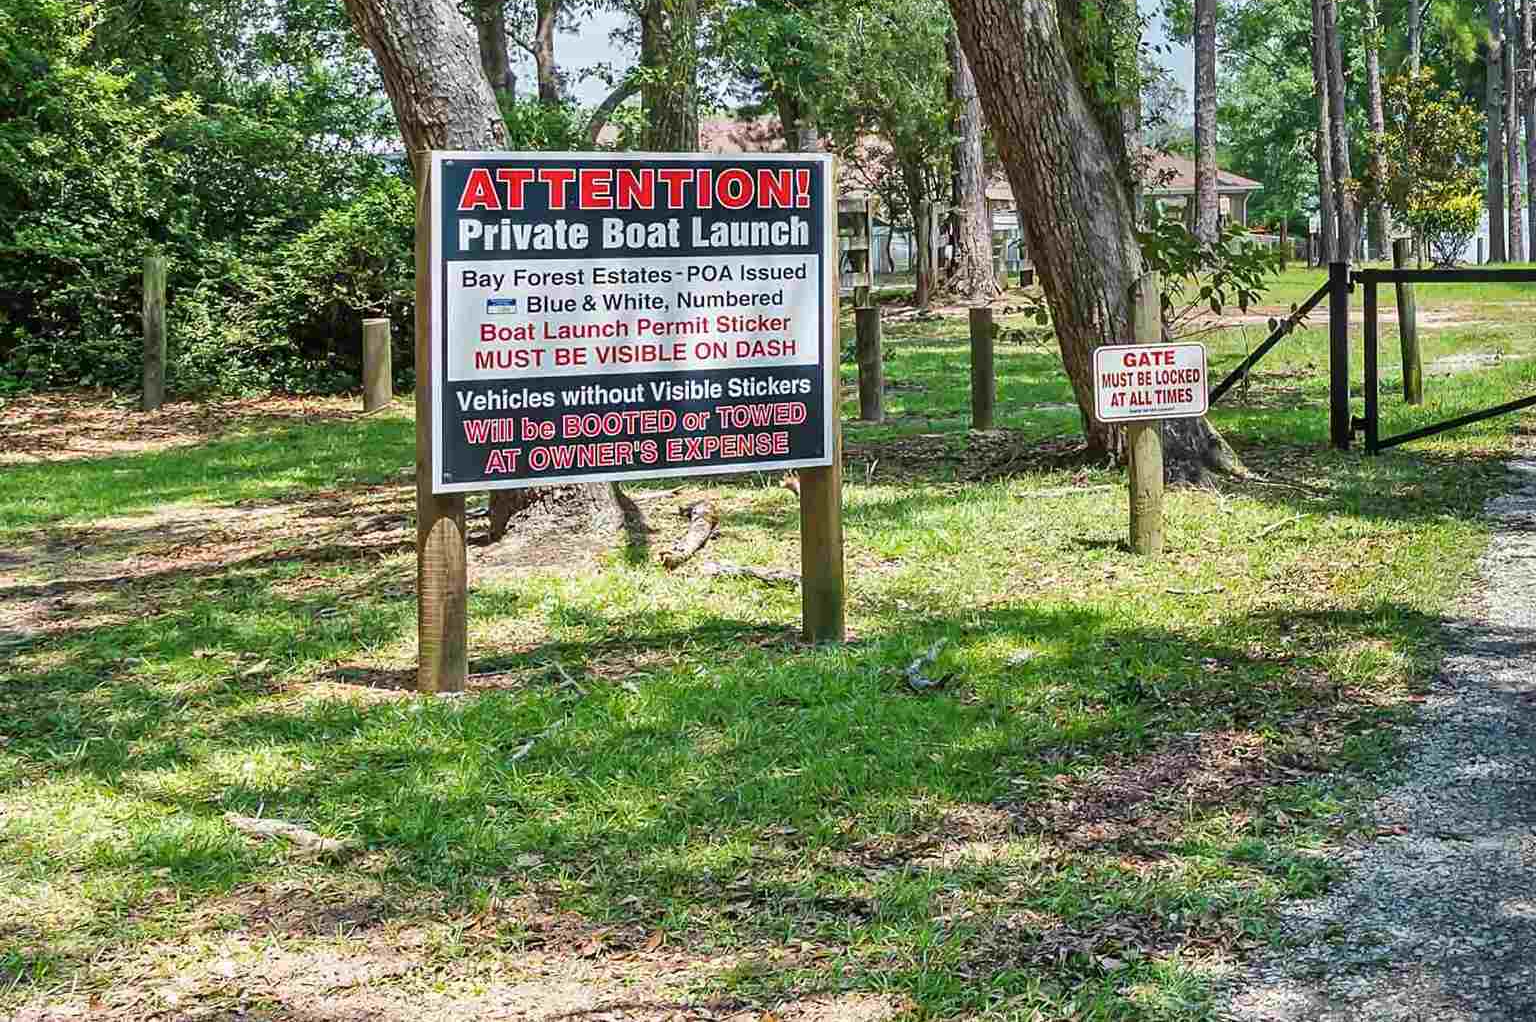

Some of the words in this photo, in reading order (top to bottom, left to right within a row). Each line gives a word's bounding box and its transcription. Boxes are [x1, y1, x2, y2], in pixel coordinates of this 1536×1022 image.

[457, 168, 811, 211] ATTENTION!
[458, 218, 589, 251] Private
[602, 217, 681, 249] Boat
[691, 215, 809, 248] Launch
[462, 270, 505, 292] Bay
[513, 268, 585, 287] Forest
[740, 262, 807, 281] Issued
[527, 295, 577, 314] Blue
[581, 294, 597, 312] &
[602, 291, 669, 311] White,
[676, 289, 784, 309] Numbered
[479, 323, 535, 342] Boat
[543, 319, 629, 340] Launch
[636, 316, 710, 336] Permit
[715, 314, 792, 333] Sticker
[474, 348, 545, 370] MUST
[554, 347, 588, 366] BE
[595, 342, 687, 364] VISIBLE
[694, 341, 728, 360] ON
[735, 339, 797, 358] DASH
[1123, 350, 1175, 367] GATE
[1102, 372, 1133, 388] MUST
[1137, 370, 1152, 386] BE
[1155, 368, 1200, 385] LOCKED
[456, 388, 556, 412] Vehicles
[561, 382, 645, 407] without
[650, 378, 722, 402] Visible
[727, 376, 812, 398] Stickers
[1111, 392, 1126, 407] AT
[1129, 390, 1152, 405] ALL
[1154, 387, 1193, 404] TIMES
[463, 416, 515, 445] Will
[521, 416, 556, 442] be
[562, 409, 677, 438] BOOTED
[682, 410, 711, 431] or
[716, 401, 808, 429] TOWED
[484, 448, 523, 475] AT
[528, 440, 658, 470] OWNER'S
[665, 431, 790, 461] EXPENSE
